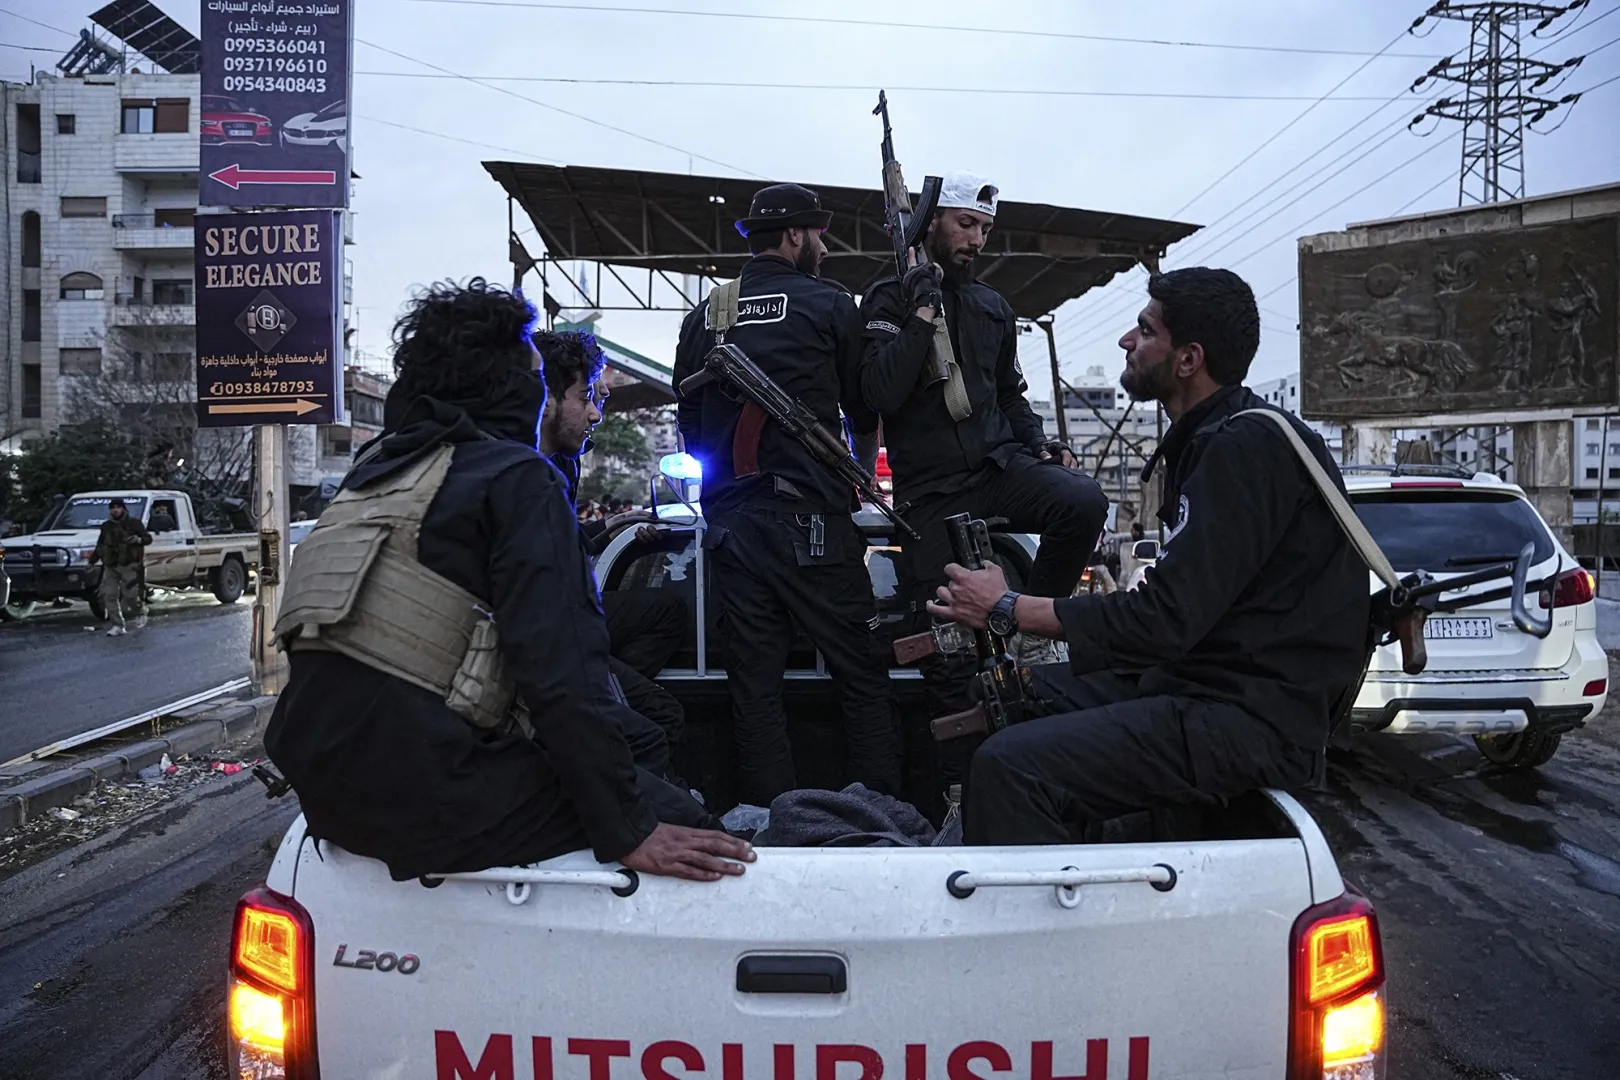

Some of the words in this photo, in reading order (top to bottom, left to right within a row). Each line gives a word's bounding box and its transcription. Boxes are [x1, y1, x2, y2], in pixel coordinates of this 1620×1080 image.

[207, 0, 248, 14] السيارات
[250, 0, 275, 15] أنواع
[275, 5, 304, 16] جميع
[305, 4, 340, 17] استيراد
[265, 20, 288, 35] شراء
[224, 37, 326, 54] 0995366041
[223, 57, 327, 74] 0937196610
[223, 76, 327, 93] 0954340843
[205, 224, 320, 257] SECURE
[205, 262, 322, 288] ELEGANCE
[738, 303, 756, 315] الأم
[200, 354, 219, 368] جاهزة
[219, 354, 240, 367] داخلية
[240, 351, 258, 366] أبواب
[263, 353, 284, 366] خارجية
[284, 354, 309, 363] مصفحة
[309, 349, 327, 365] أبواب
[250, 366, 262, 378] بناء
[263, 366, 278, 378] مواد
[225, 380, 315, 395] 0938478793
[333, 944, 420, 975] L200
